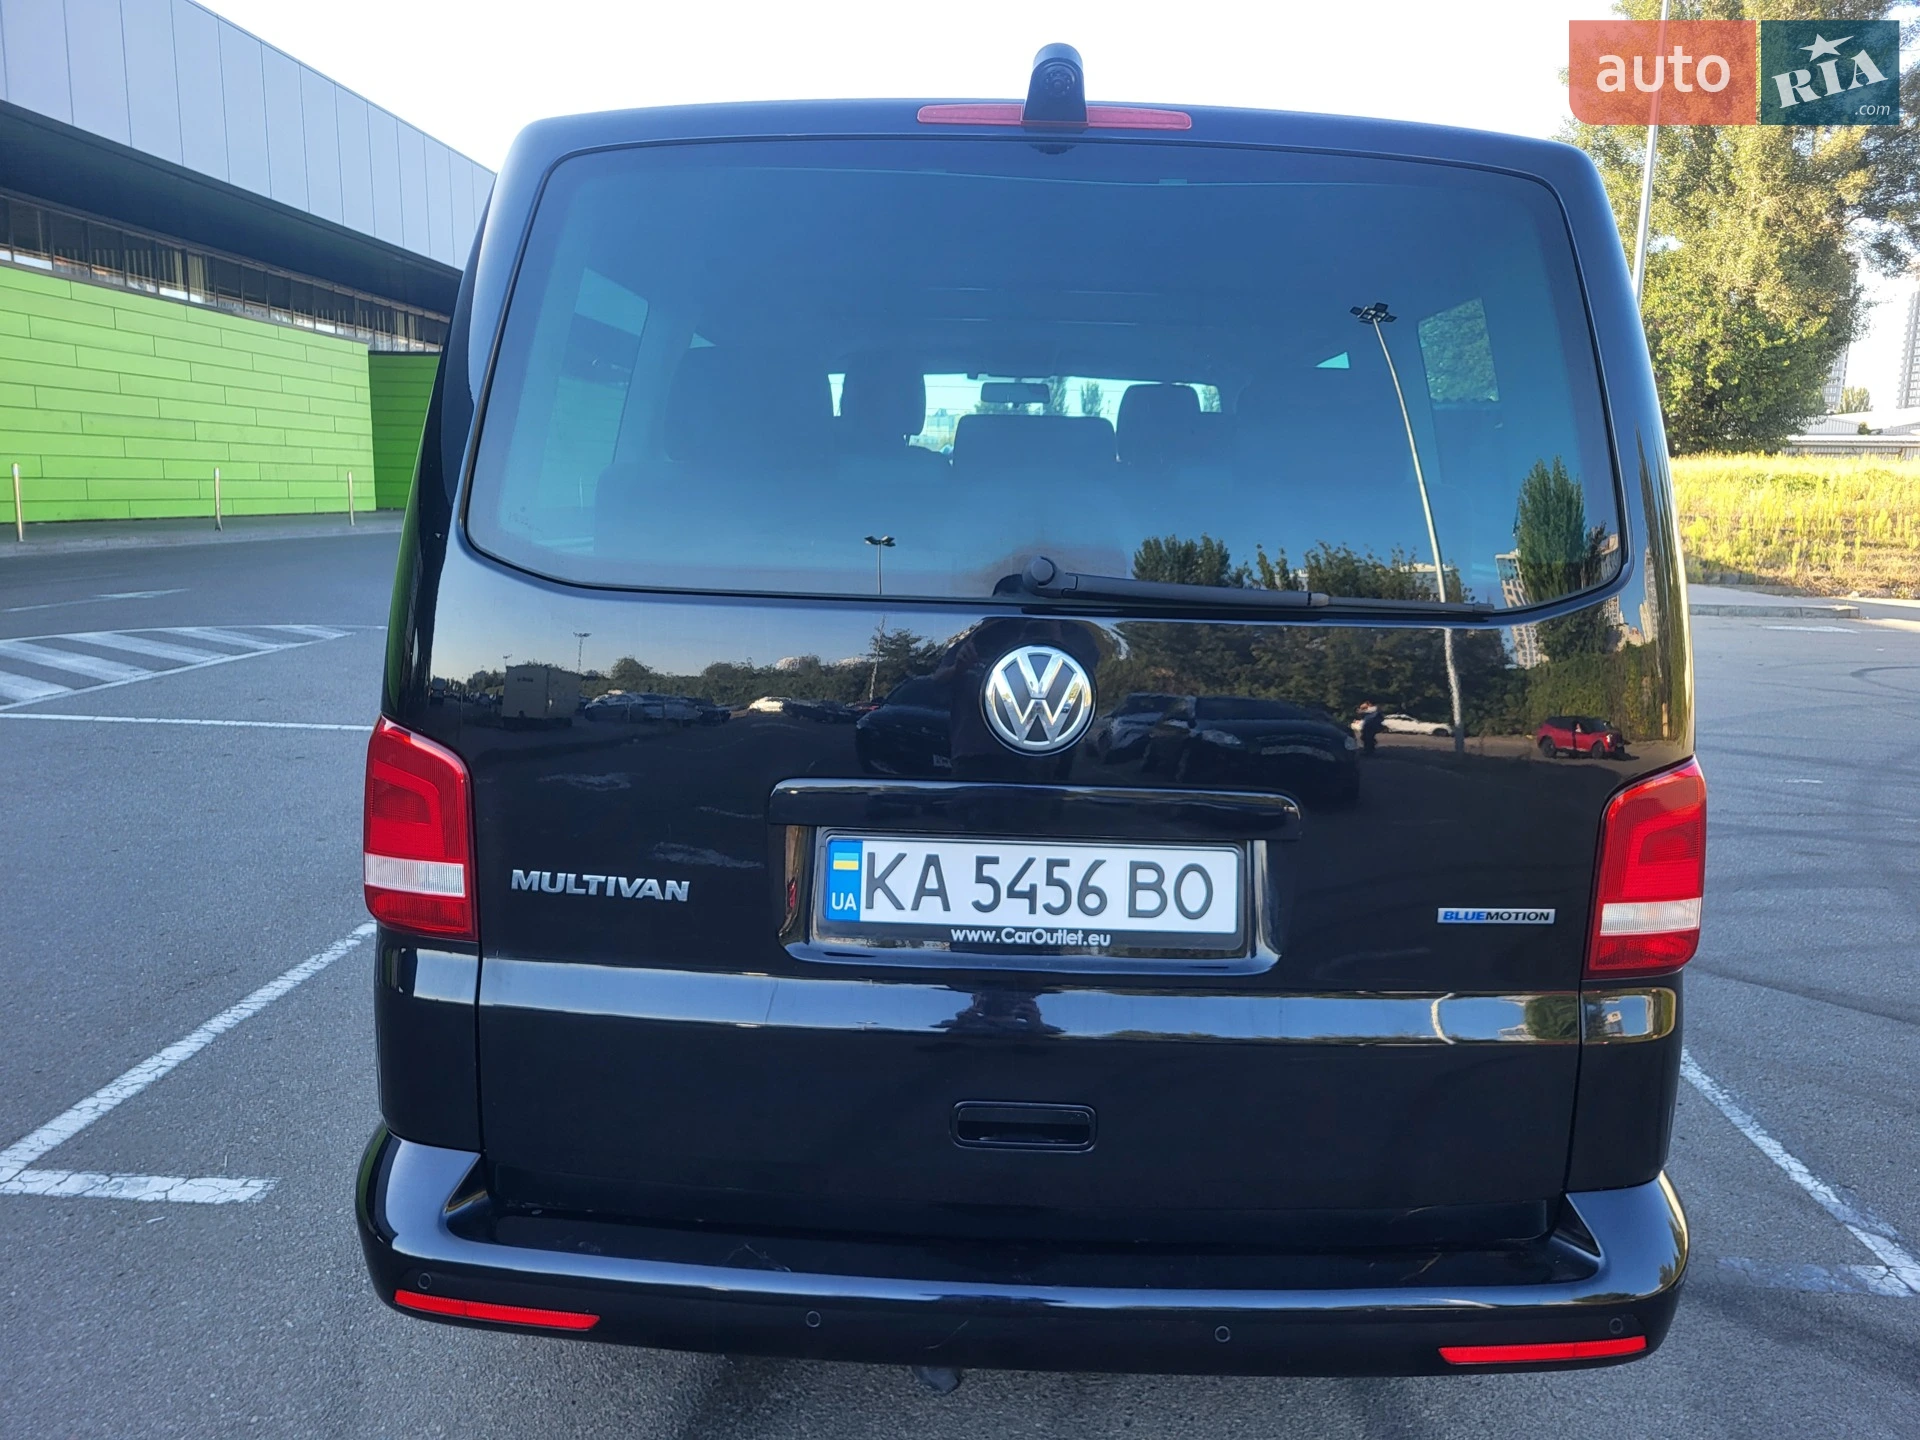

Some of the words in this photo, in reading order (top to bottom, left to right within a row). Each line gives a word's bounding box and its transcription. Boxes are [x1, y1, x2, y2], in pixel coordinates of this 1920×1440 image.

[984, 645, 1092, 751] VW
[510, 868, 691, 902] MULTIVAN
[865, 851, 951, 912] KA
[970, 855, 1108, 918] 5456
[1127, 860, 1214, 920] BO
[831, 891, 857, 912] UA
[1442, 910, 1551, 922] BLUEMOTION
[950, 927, 1112, 948] www.CarOutlet.eu
